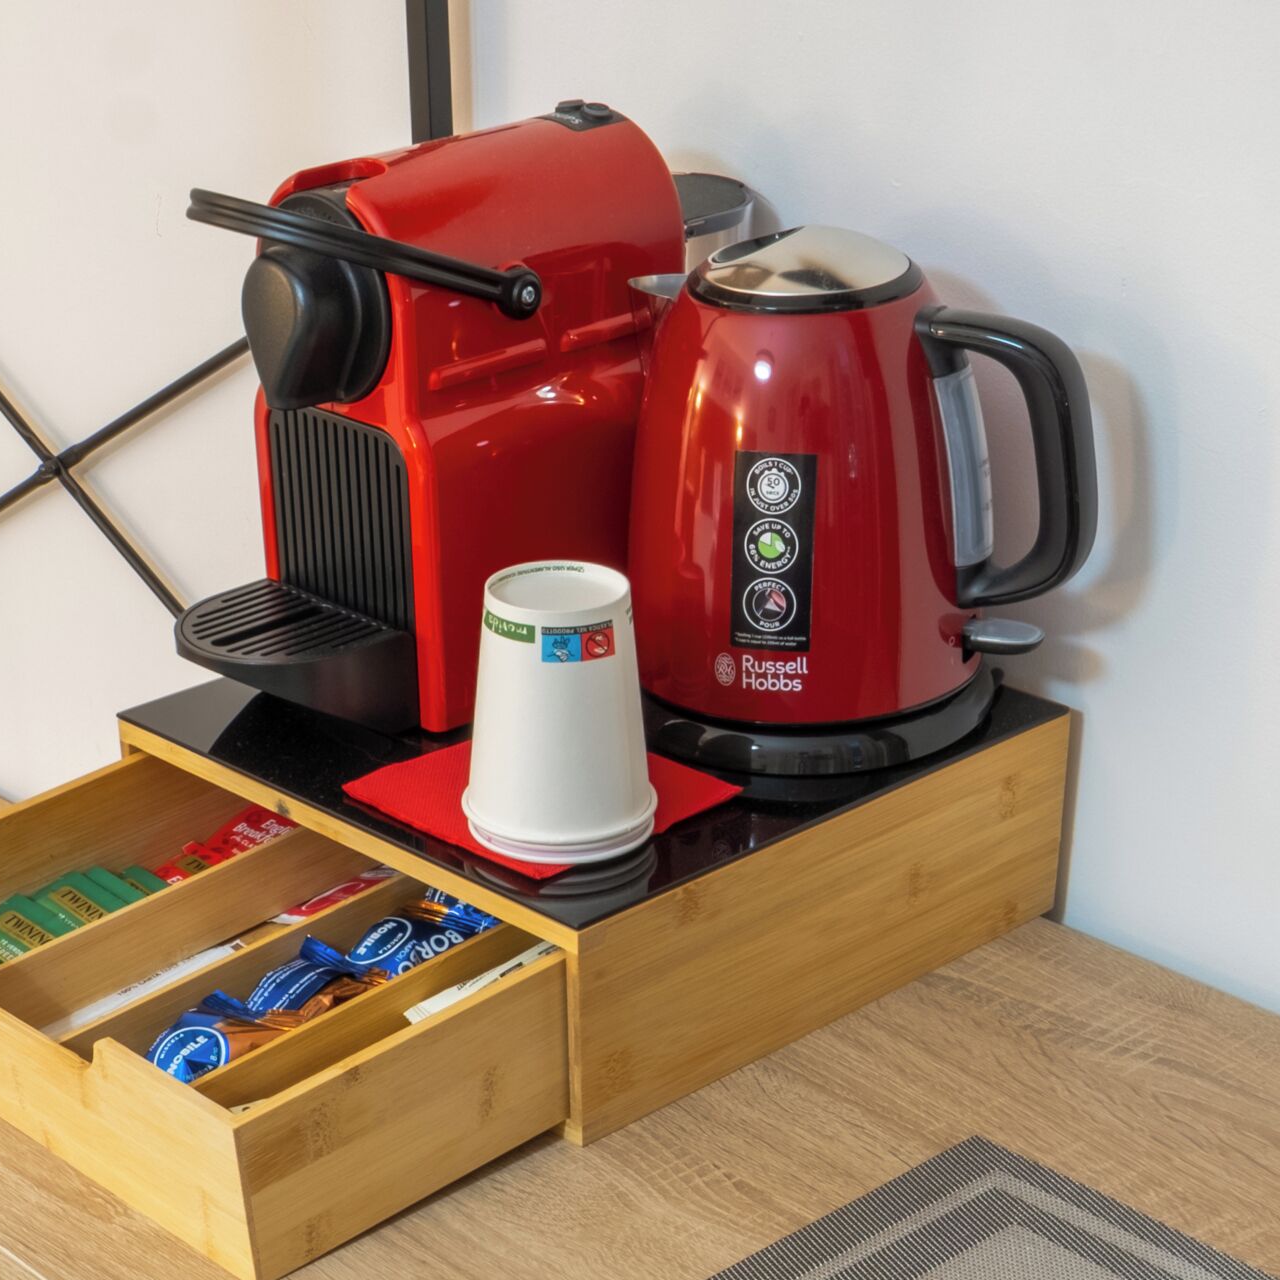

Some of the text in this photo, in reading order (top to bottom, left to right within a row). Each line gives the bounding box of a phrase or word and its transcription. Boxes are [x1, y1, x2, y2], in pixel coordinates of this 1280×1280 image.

[754, 581, 786, 592] PERFECT
[759, 620, 780, 629] POUR
[742, 655, 808, 674] Russell
[742, 672, 802, 692] Hobbs
[356, 921, 398, 956] NOBILE
[167, 1035, 209, 1076] NOBILE
